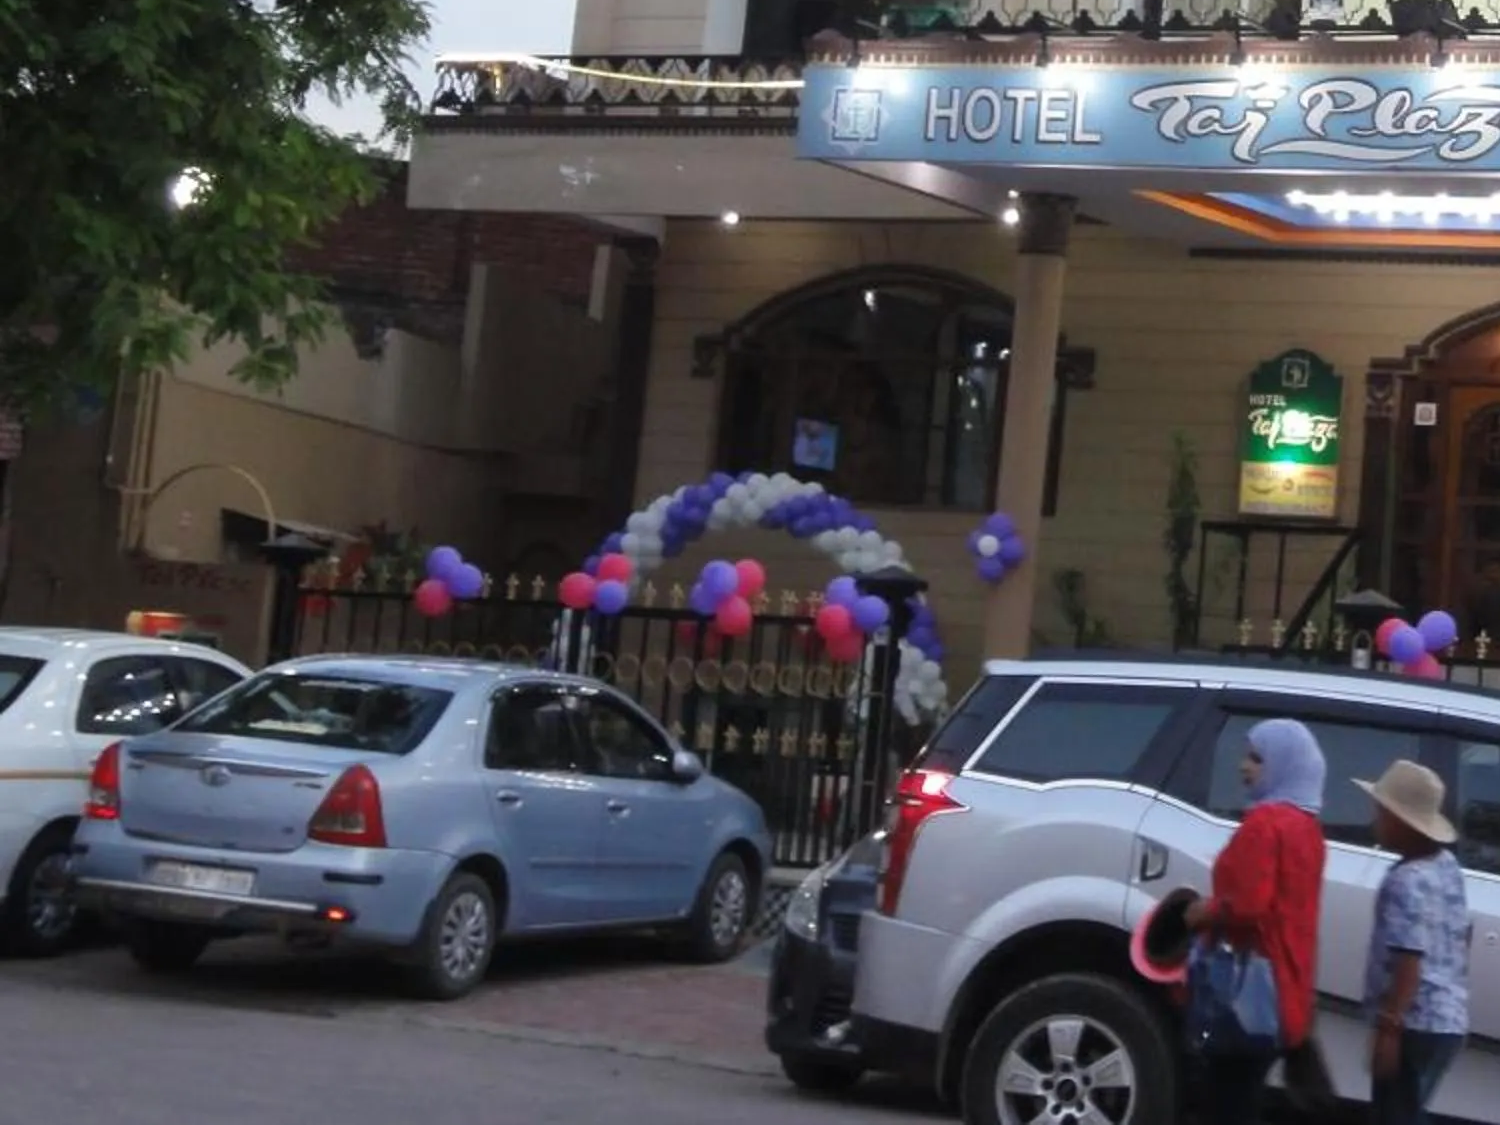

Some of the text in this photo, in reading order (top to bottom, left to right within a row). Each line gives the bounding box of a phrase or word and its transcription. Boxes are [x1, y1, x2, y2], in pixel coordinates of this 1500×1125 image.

[924, 87, 1102, 143] HOTEL
[1130, 78, 1288, 163] Taj
[1249, 394, 1287, 407] HOTEL
